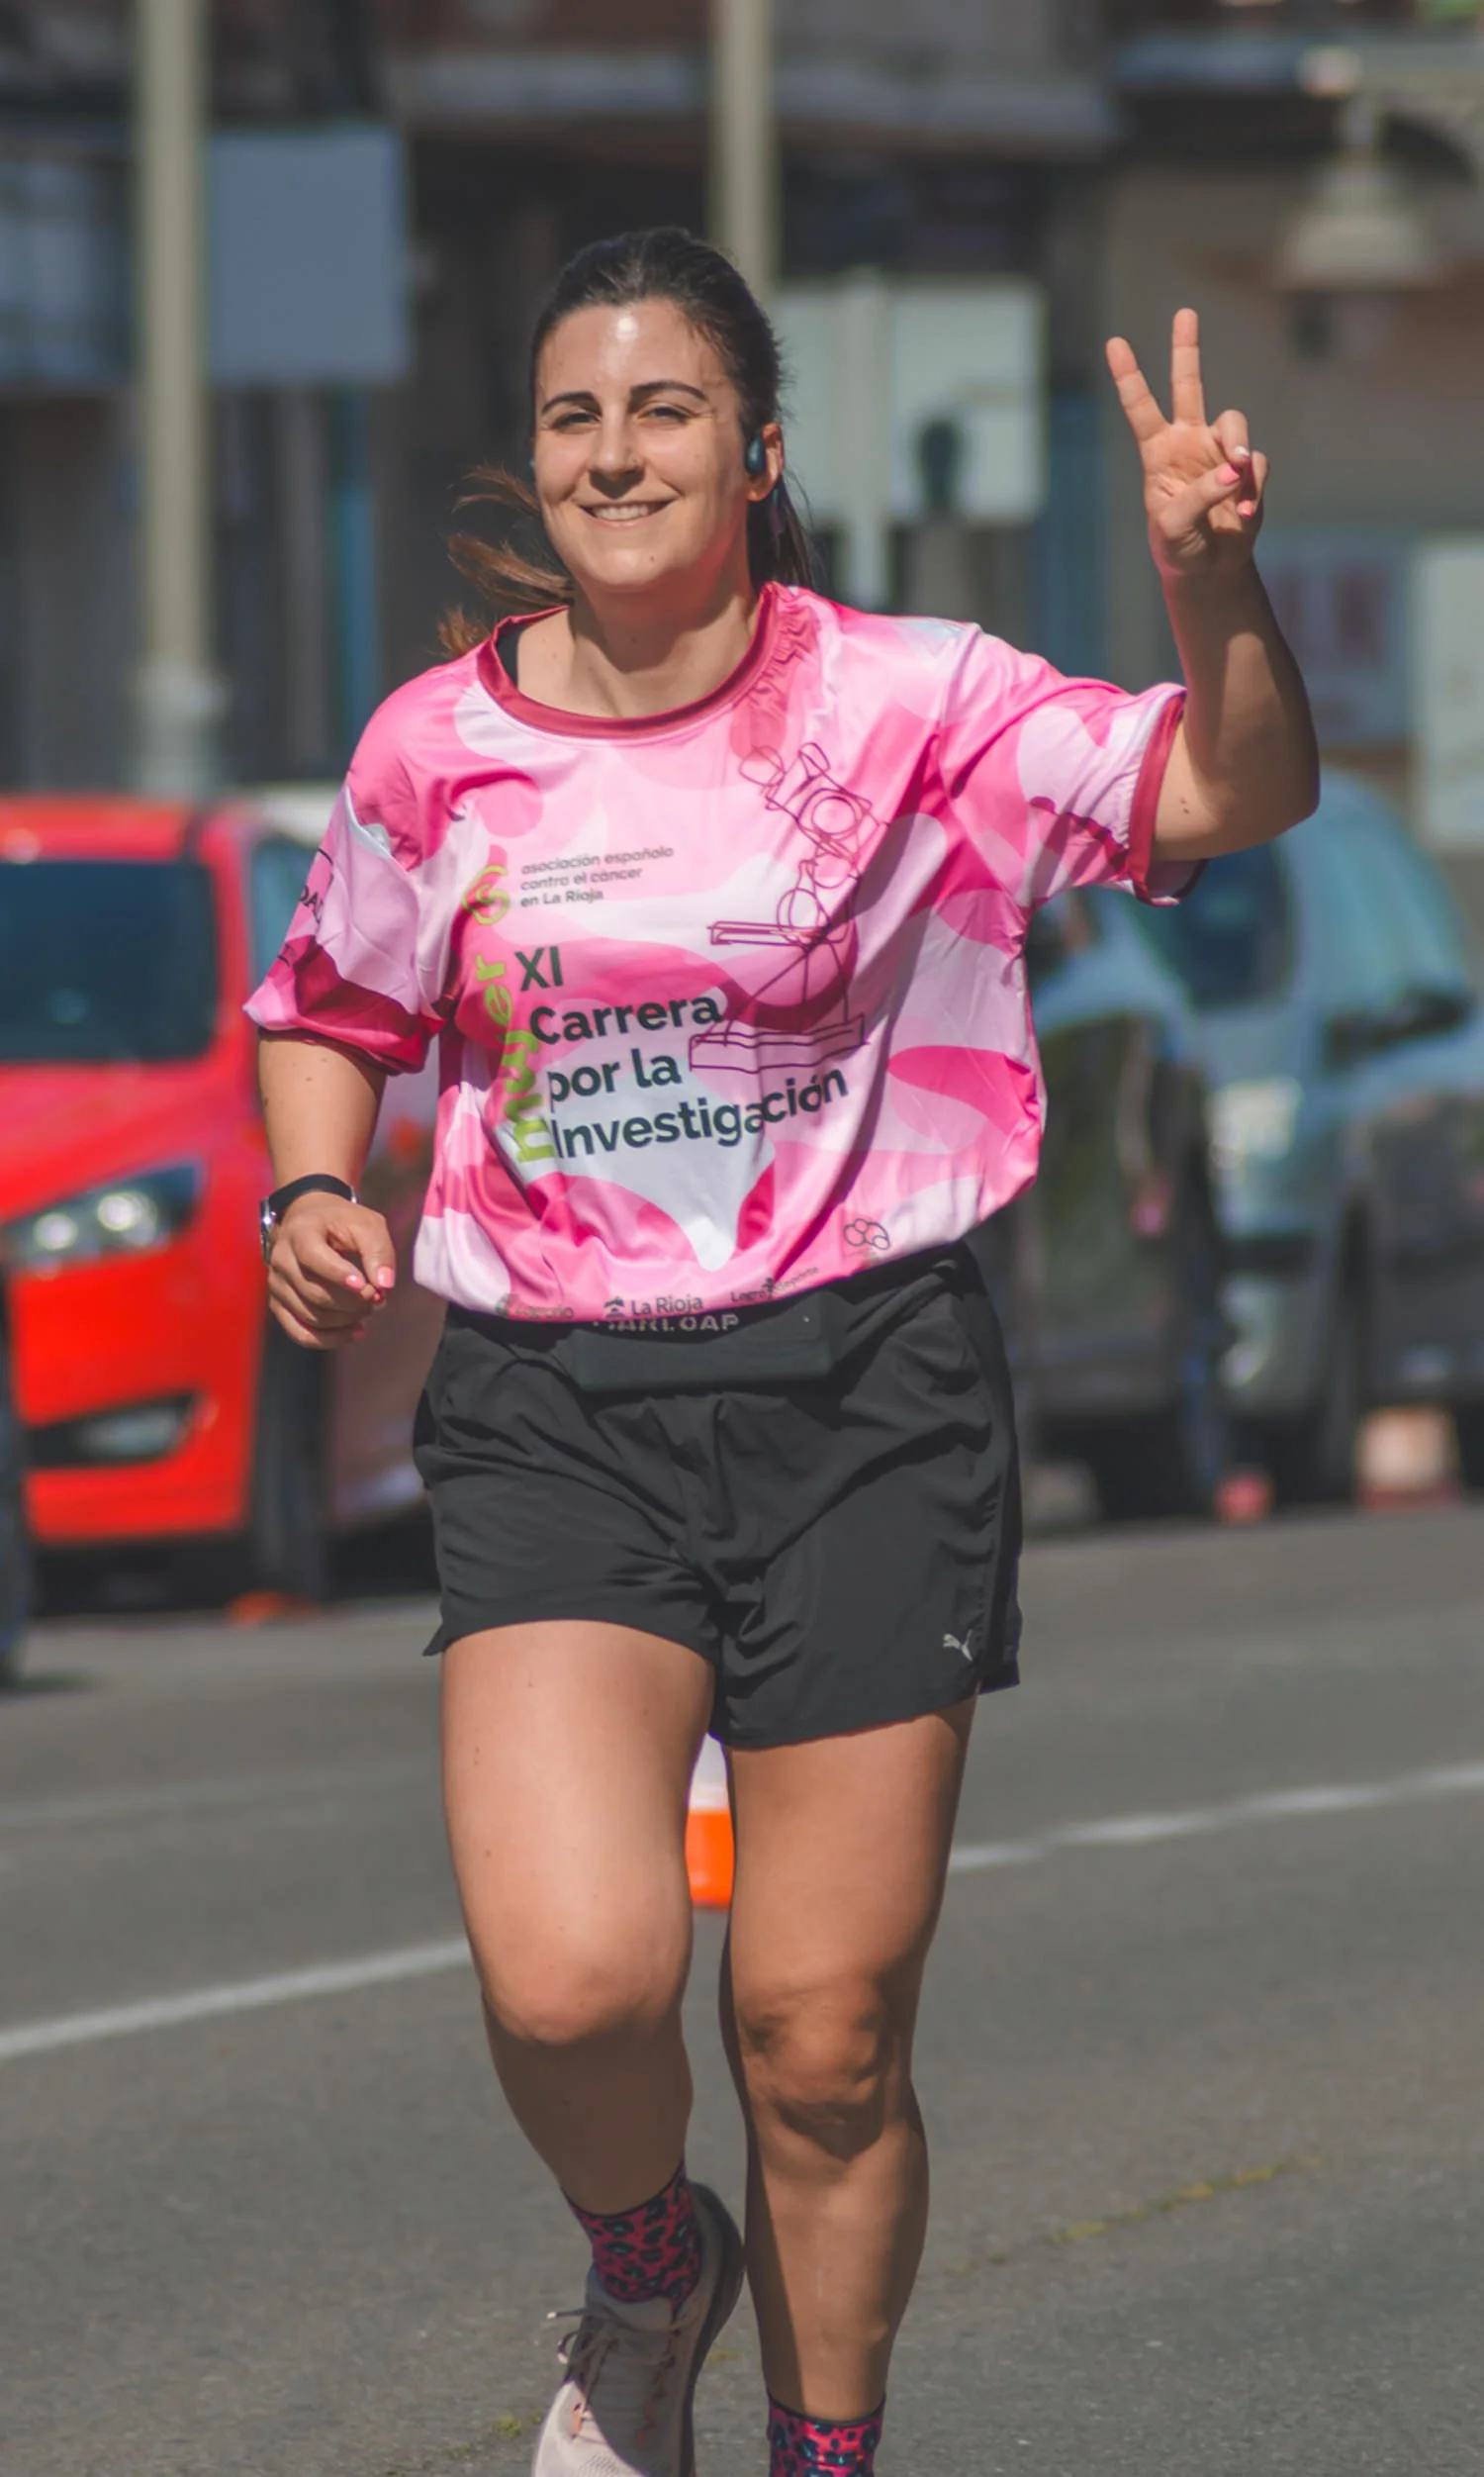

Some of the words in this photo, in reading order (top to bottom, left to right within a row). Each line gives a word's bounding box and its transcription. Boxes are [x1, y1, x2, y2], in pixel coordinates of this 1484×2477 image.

[520, 896, 539, 907] en
[543, 893, 562, 905] La
[565, 889, 603, 904] Rioja
[573, 872, 588, 886] el
[514, 945, 564, 992] XI
[529, 995, 723, 1045] Carrera
[547, 1062, 620, 1113] por
[631, 1048, 683, 1088] la
[551, 1068, 848, 1159] Investigación
[631, 1299, 653, 1316] La
[655, 1293, 704, 1314] Rioja
